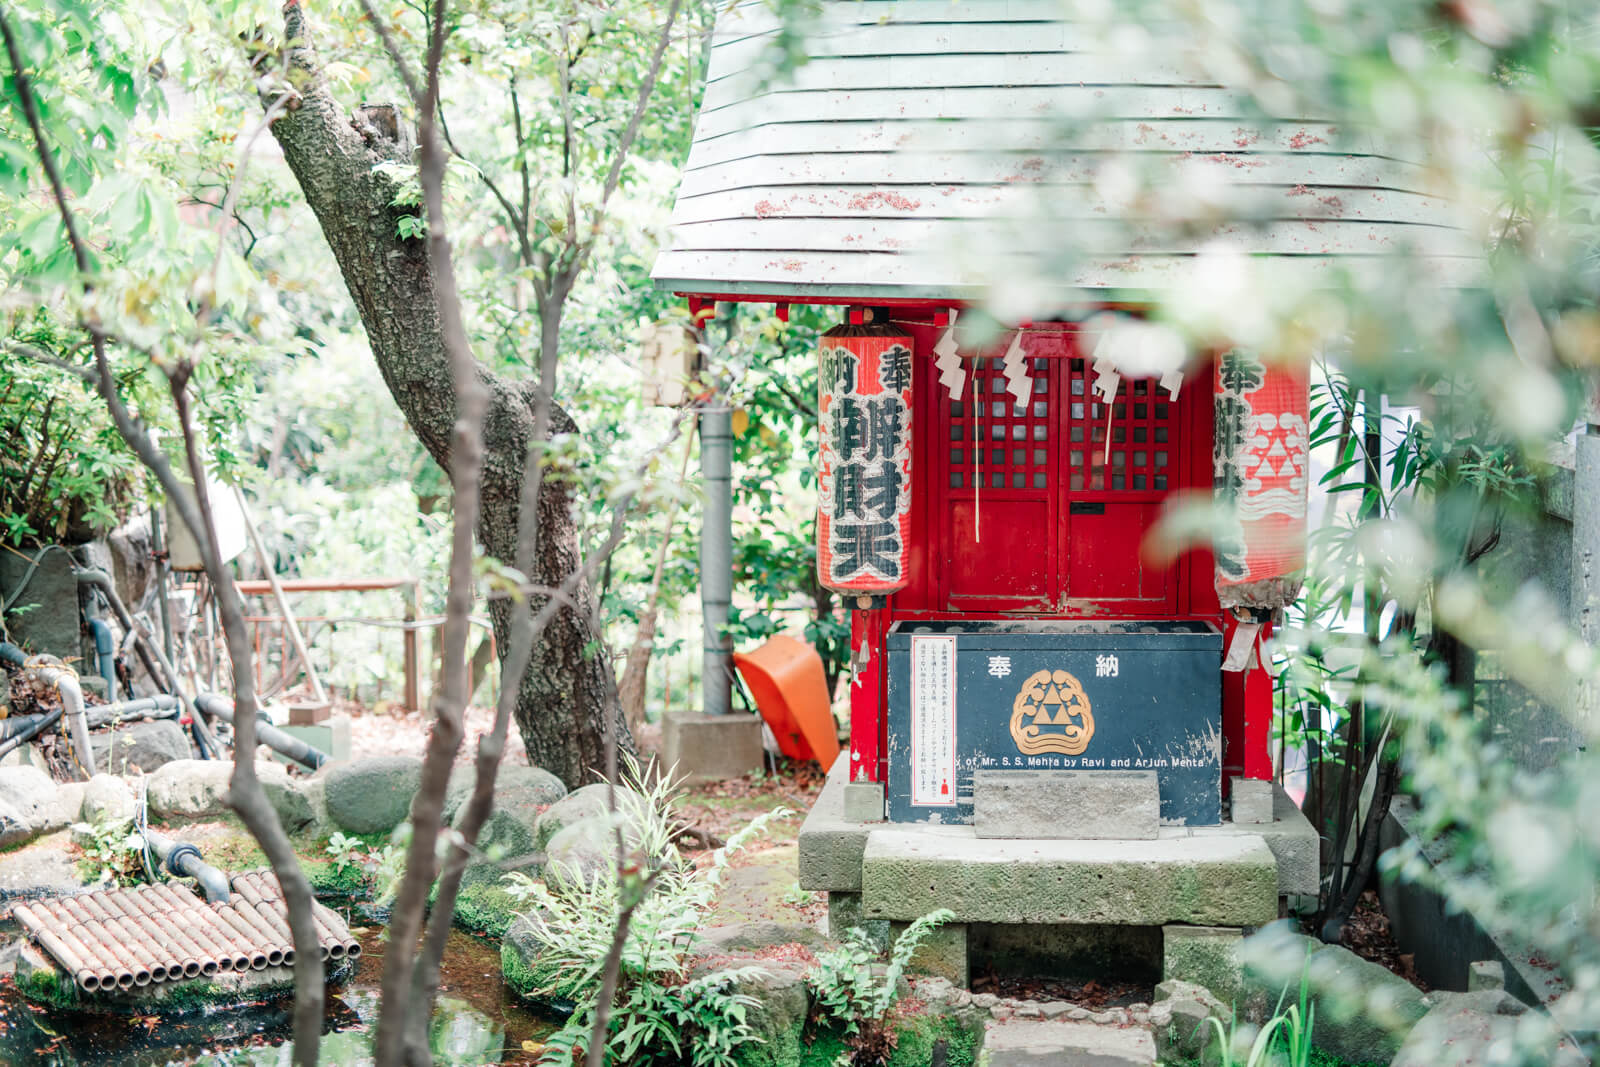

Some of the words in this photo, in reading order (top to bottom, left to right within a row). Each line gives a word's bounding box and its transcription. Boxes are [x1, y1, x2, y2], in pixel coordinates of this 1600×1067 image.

[821, 350, 856, 394] 納
[881, 347, 911, 394] 奉
[988, 655, 1012, 679] 奉
[1095, 654, 1119, 678] 納
[965, 757, 977, 767] of
[982, 757, 998, 766] Mr.
[1028, 757, 1060, 767] Mehta
[1064, 757, 1077, 768] by
[1081, 757, 1105, 767] Ravi
[1110, 757, 1130, 767] and
[1134, 757, 1168, 768] Arjun
[1171, 756, 1205, 768] Mehta
